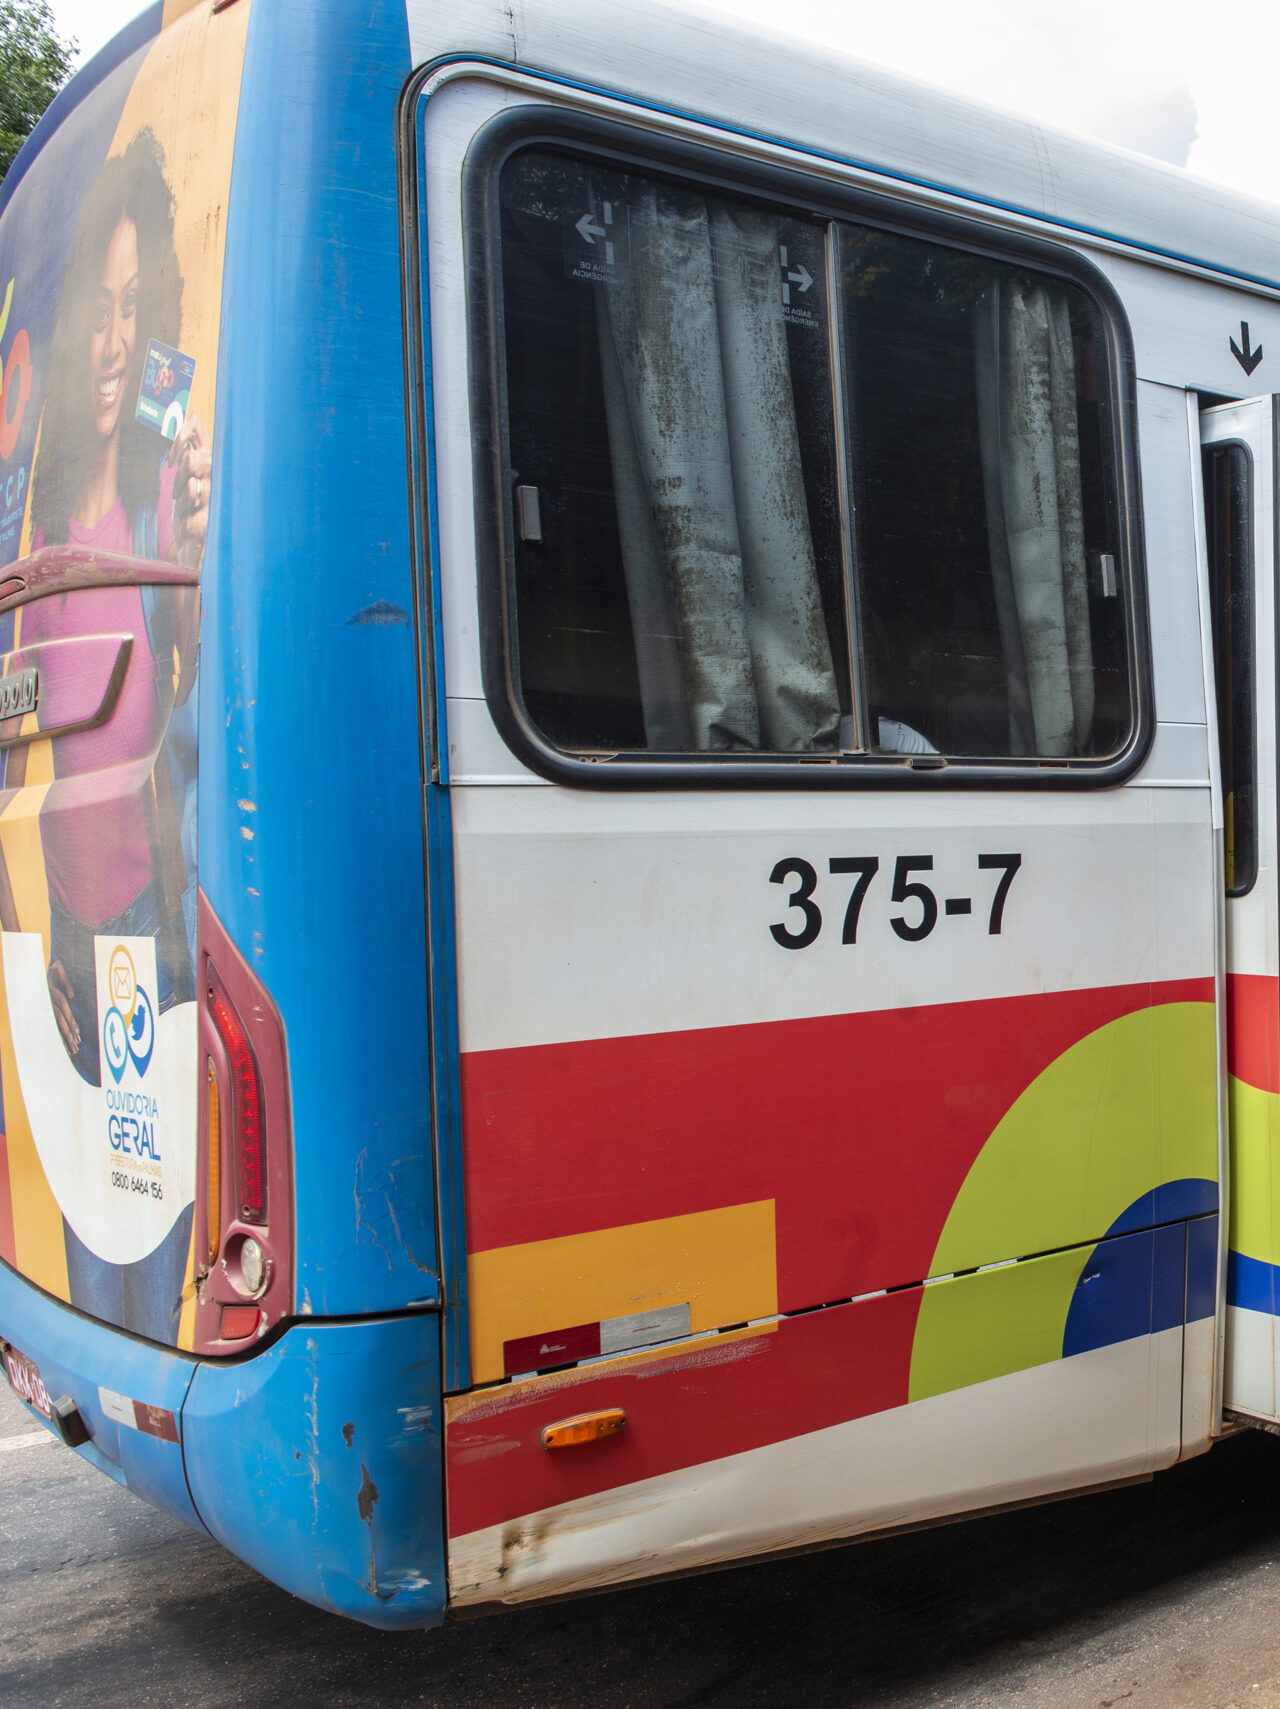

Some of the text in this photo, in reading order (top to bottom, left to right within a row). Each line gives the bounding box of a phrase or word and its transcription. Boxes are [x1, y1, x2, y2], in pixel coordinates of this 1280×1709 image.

[769, 853, 1022, 950] 375-7
[106, 1089, 159, 1119] OUVIDORIA
[108, 1114, 161, 1161] GERAL
[111, 1171, 163, 1200] 0800 6464 156
